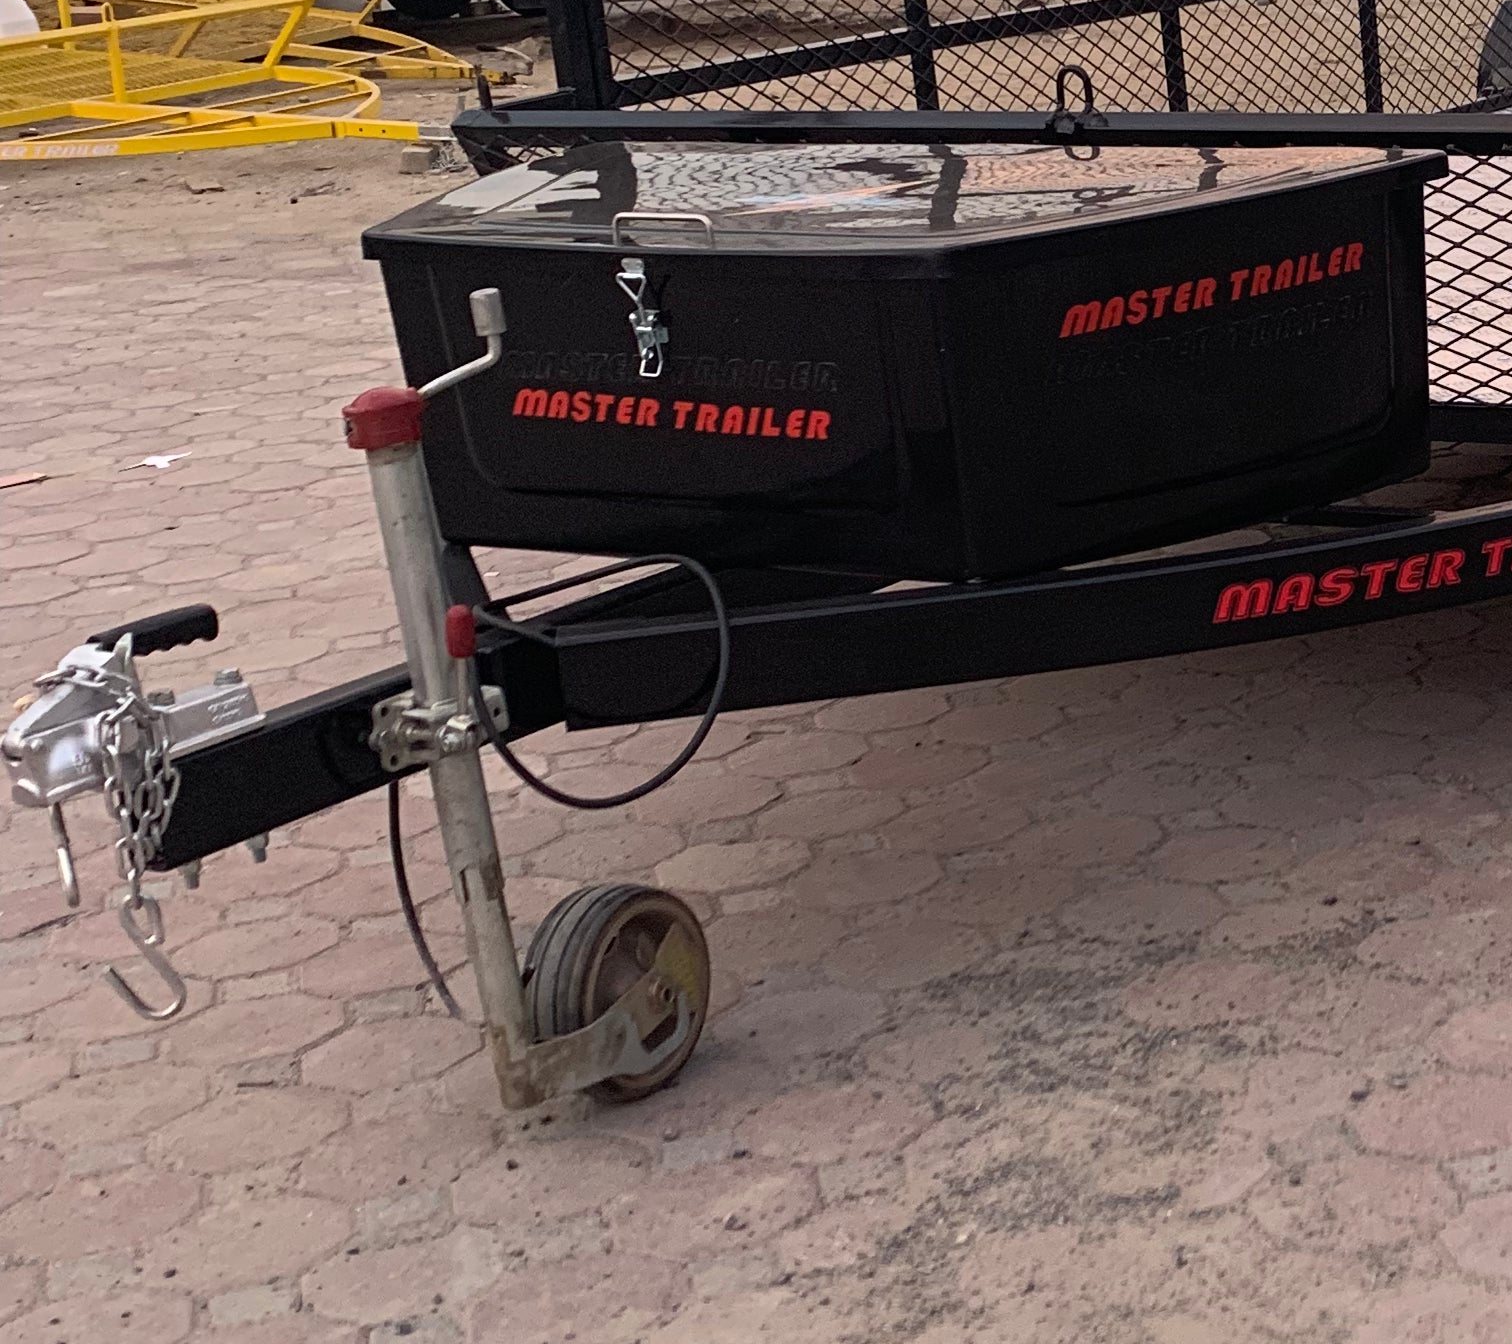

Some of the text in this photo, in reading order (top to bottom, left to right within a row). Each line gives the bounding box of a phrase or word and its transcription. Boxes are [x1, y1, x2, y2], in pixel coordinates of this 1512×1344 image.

[1058, 276, 1217, 339] MASTER
[1230, 241, 1364, 302] TRAILER
[512, 387, 832, 441] MASTER TRAILER
[1212, 547, 1467, 624] MASTER
